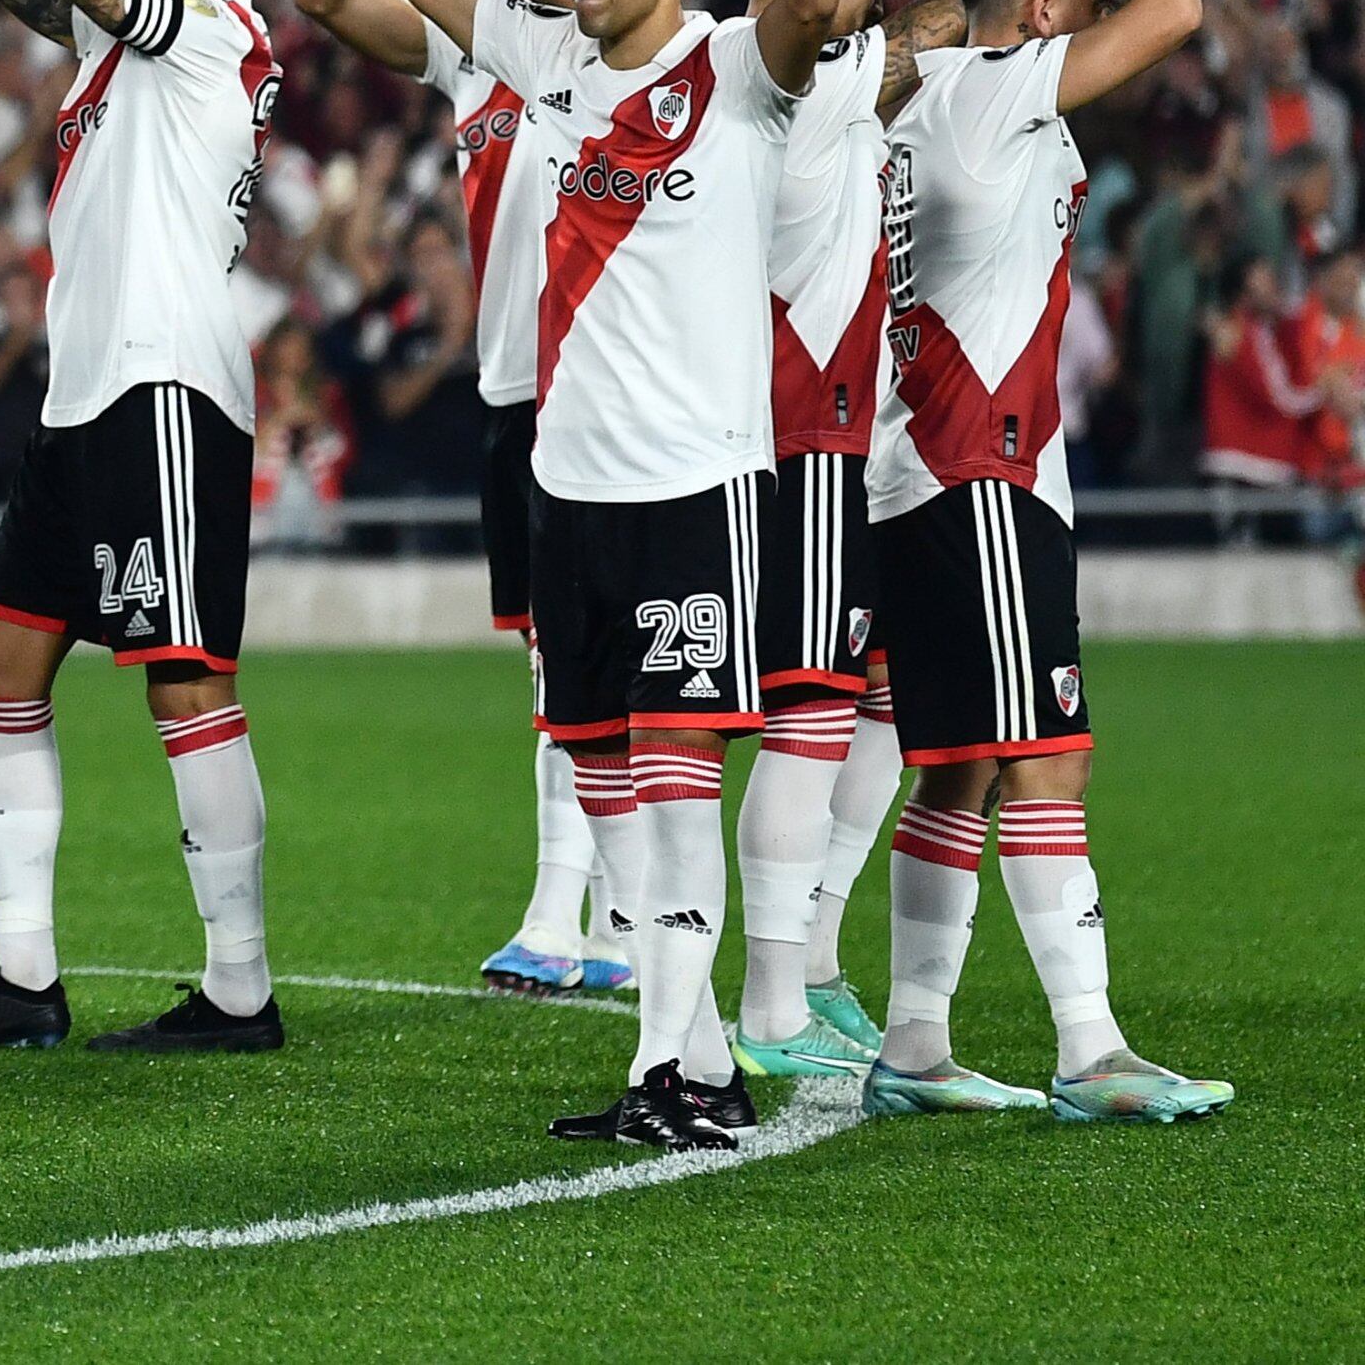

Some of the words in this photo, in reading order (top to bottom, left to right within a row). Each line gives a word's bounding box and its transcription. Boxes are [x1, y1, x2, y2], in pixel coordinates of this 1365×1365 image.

[94, 536, 165, 614] 24
[635, 593, 728, 672] 29
[679, 688, 721, 699] adidas
[653, 917, 713, 936] adidas
